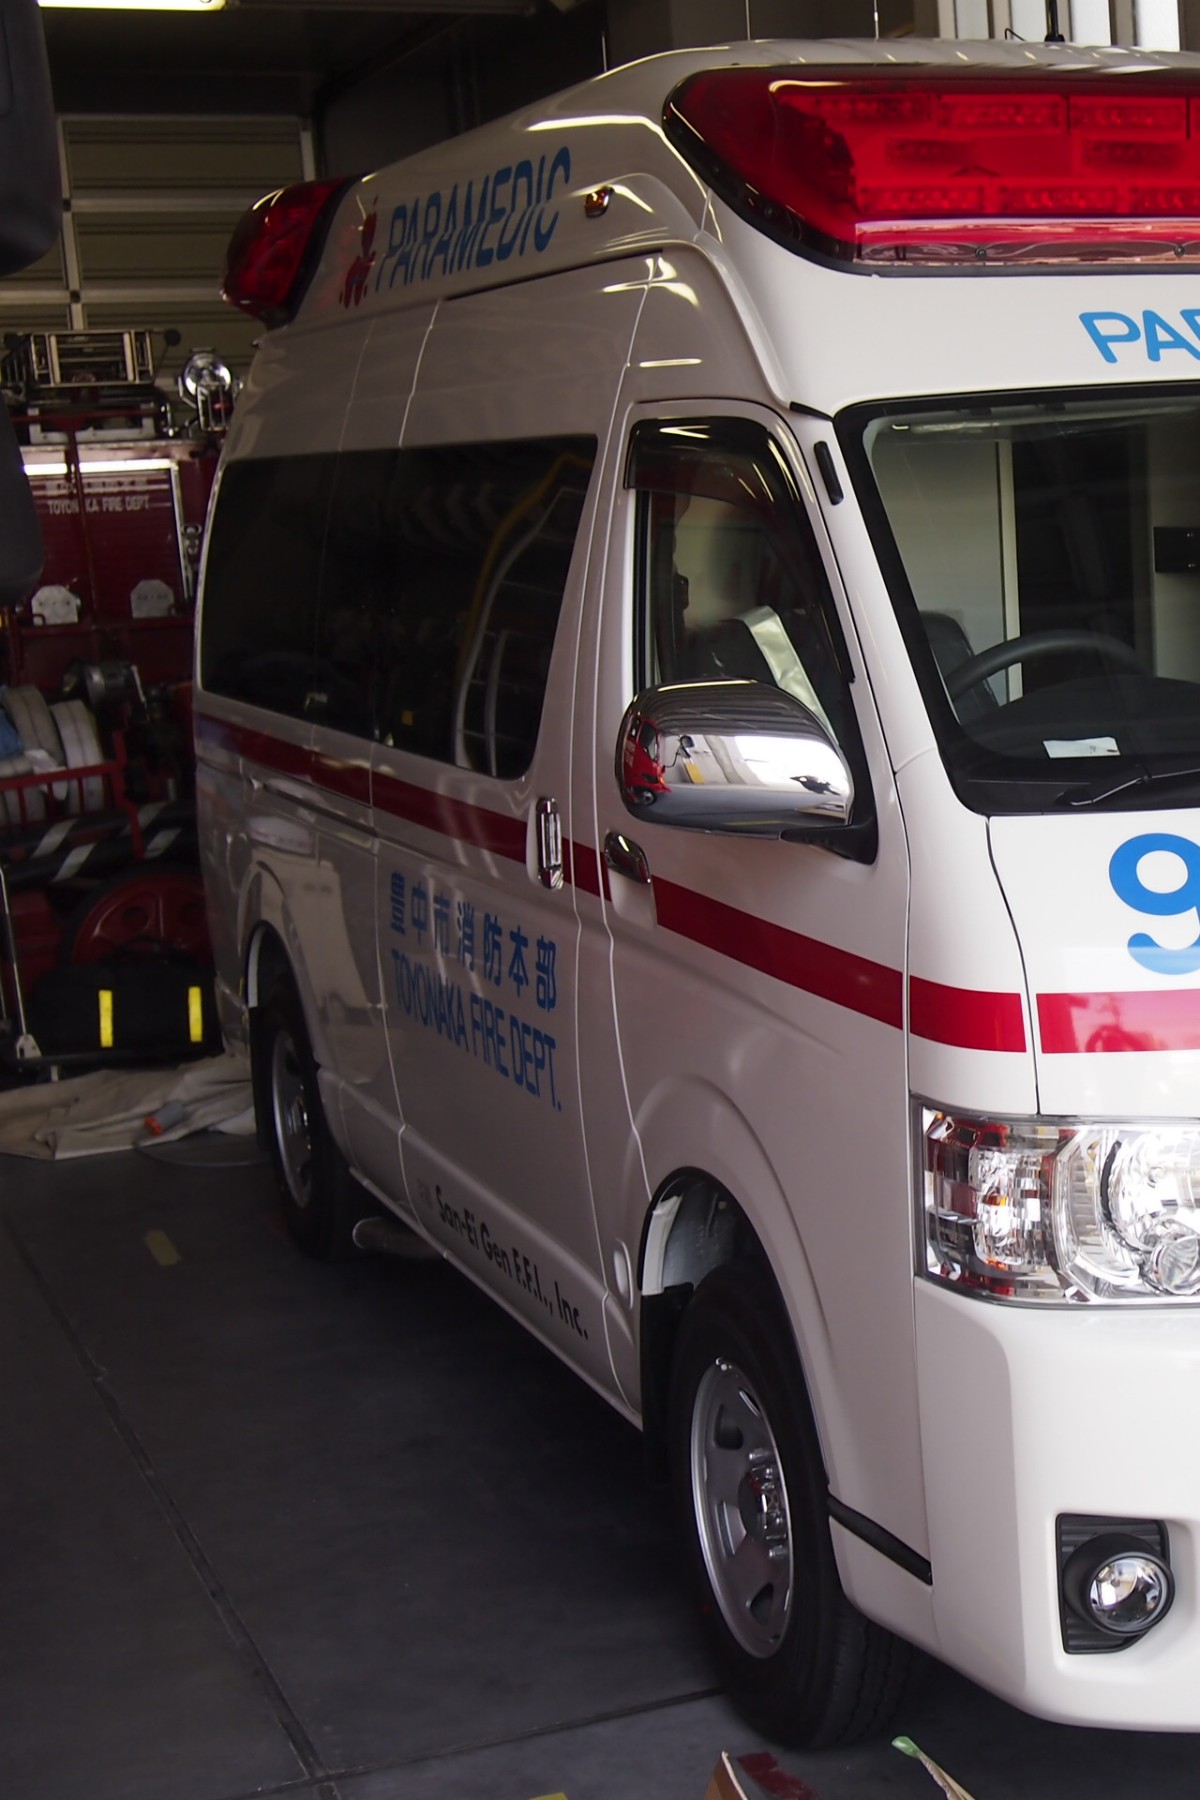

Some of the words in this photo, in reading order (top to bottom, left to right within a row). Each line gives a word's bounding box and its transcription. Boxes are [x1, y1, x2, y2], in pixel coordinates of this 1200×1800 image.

[375, 146, 571, 293] PARAMEDIC
[48, 498, 99, 515] TOYONKA
[390, 871, 557, 1012] 豊中市消防本部
[391, 948, 470, 1053] TOYONAKA
[470, 992, 509, 1078] FIRE
[509, 1014, 562, 1112] DEPT.
[435, 1184, 479, 1250] San-Ei
[480, 1221, 513, 1279] Gen
[554, 1280, 589, 1341] Inc.
